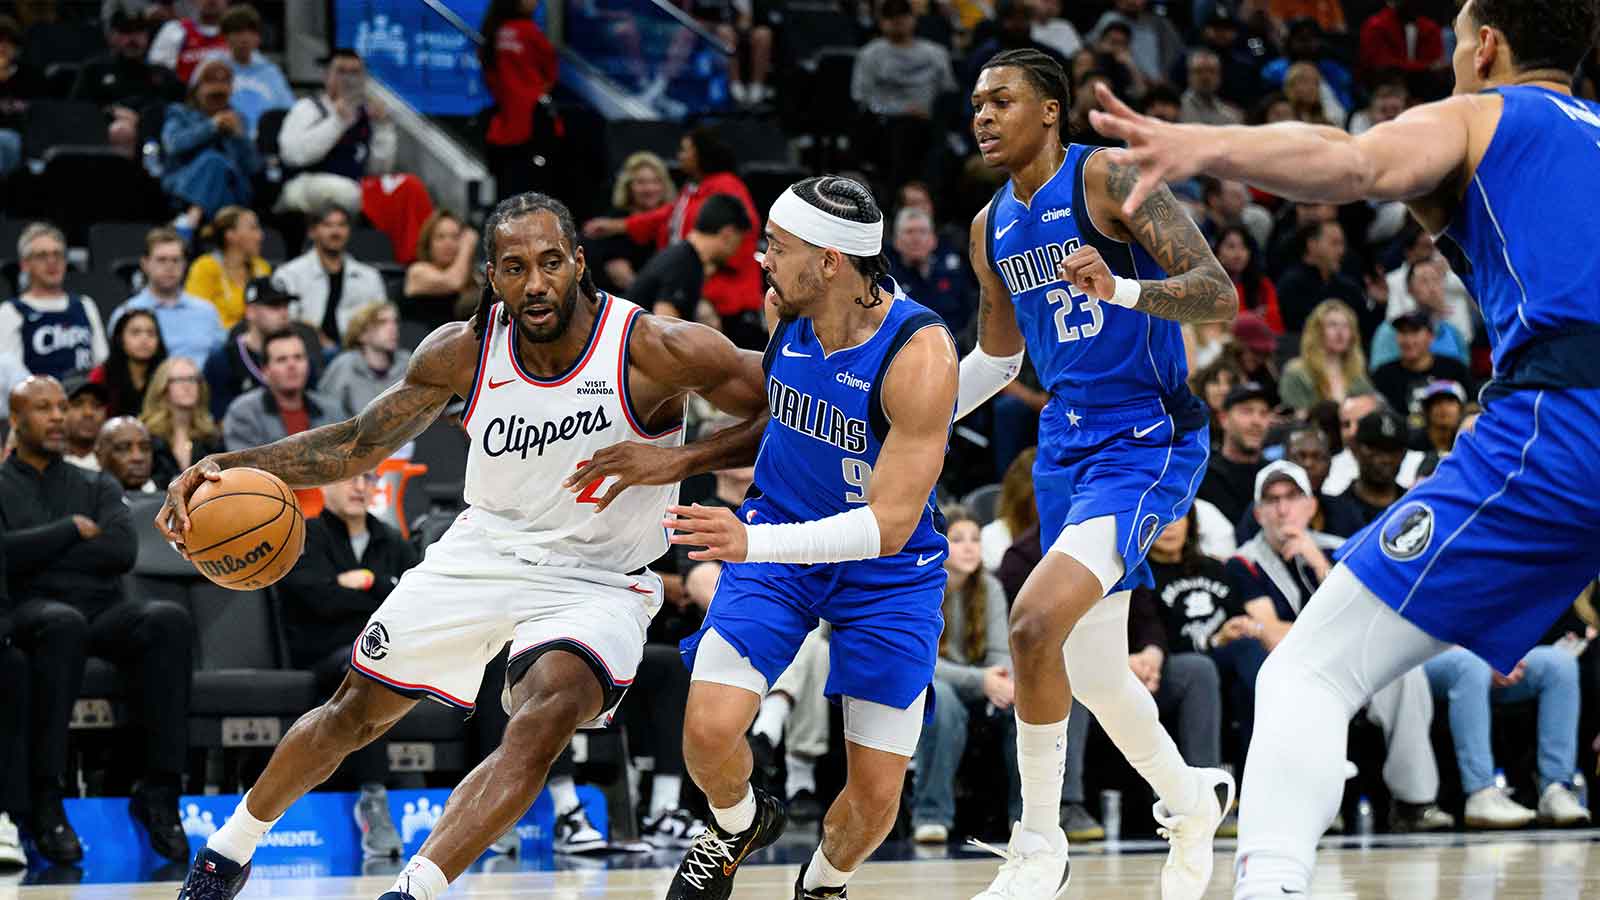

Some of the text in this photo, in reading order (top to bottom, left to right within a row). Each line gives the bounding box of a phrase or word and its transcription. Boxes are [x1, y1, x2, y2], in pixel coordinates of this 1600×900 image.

[1041, 207, 1071, 222] chime
[1046, 285, 1104, 343] 23
[836, 371, 871, 391] chime
[483, 405, 612, 460] Clippers
[768, 375, 867, 454] DALLAS
[842, 457, 872, 503] 9
[201, 541, 273, 576] Wilson
